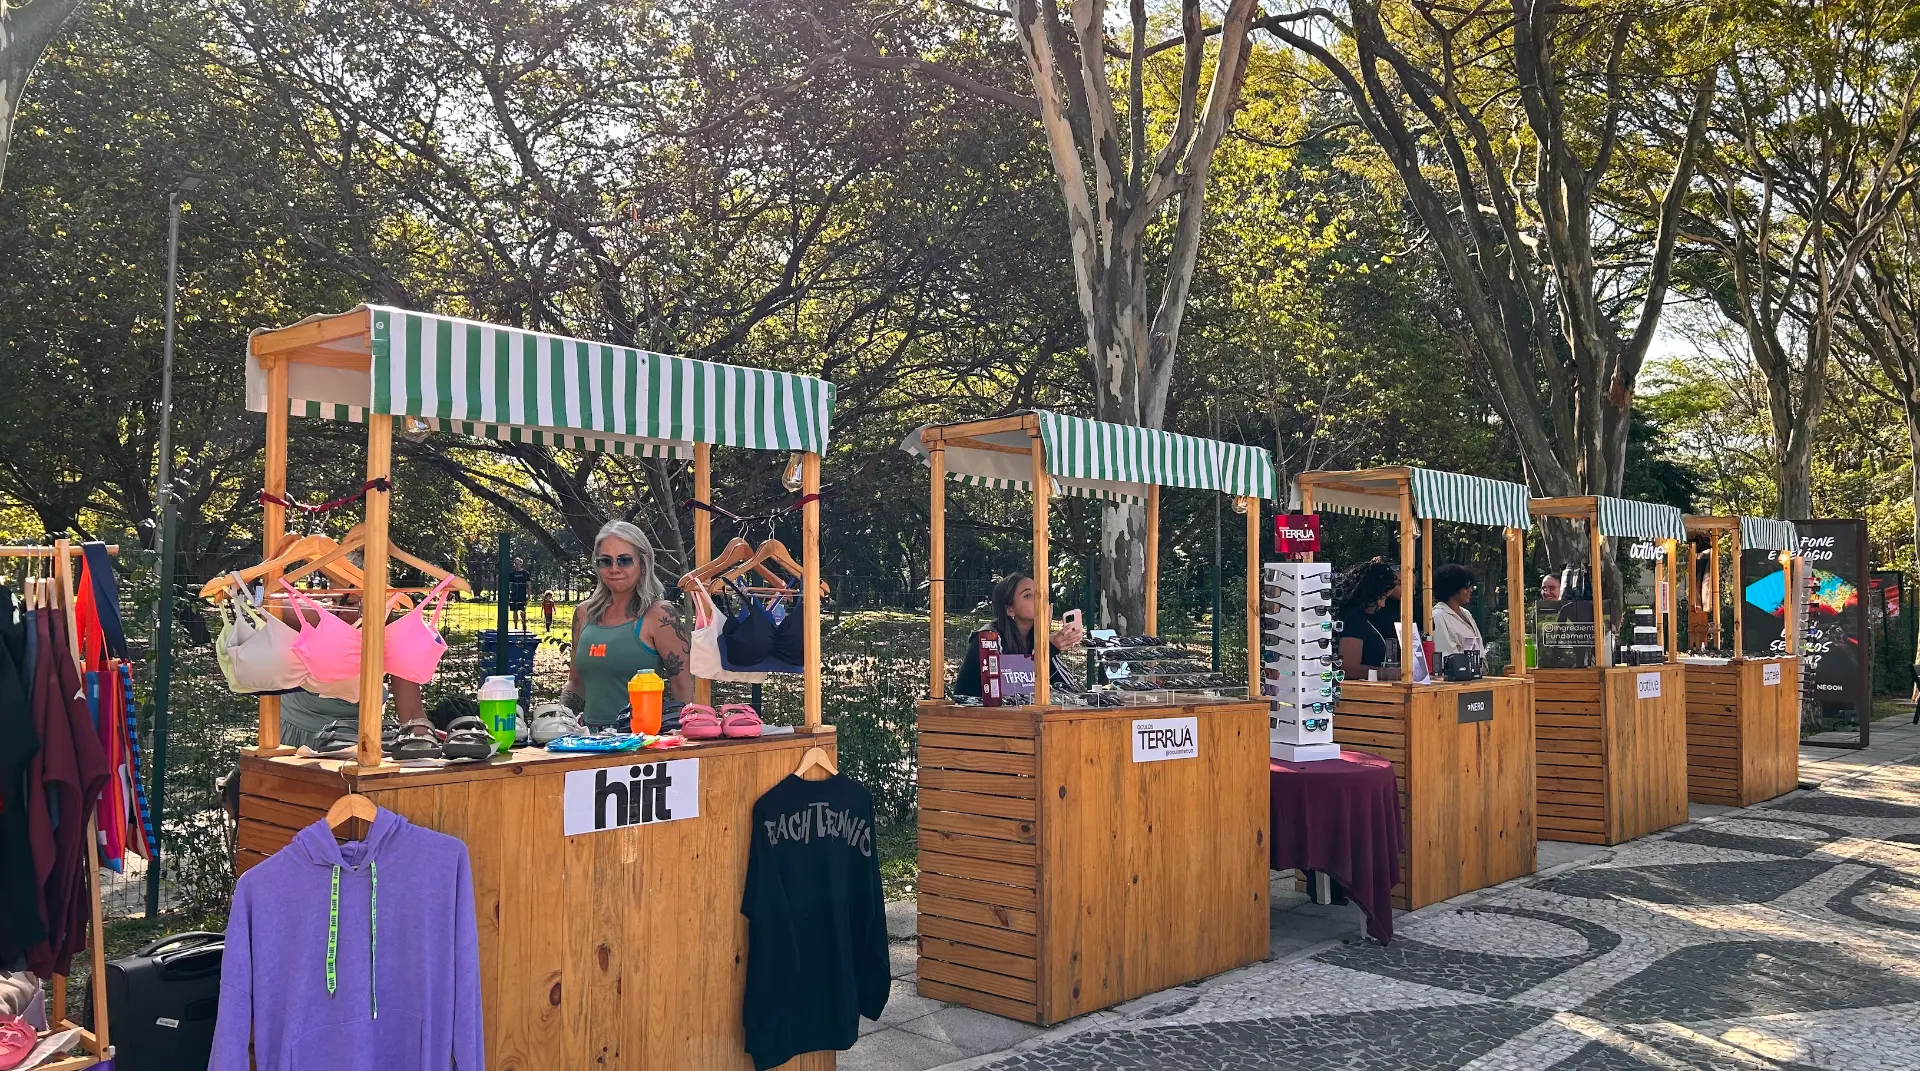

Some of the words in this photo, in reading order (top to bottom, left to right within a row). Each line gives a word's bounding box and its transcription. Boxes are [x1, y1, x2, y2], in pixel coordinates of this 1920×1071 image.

[1800, 536, 1835, 548] FONE
[1788, 547, 1833, 561] ELÓGIO
[1137, 724, 1193, 750] TERRUÁ
[594, 762, 672, 830] hiit
